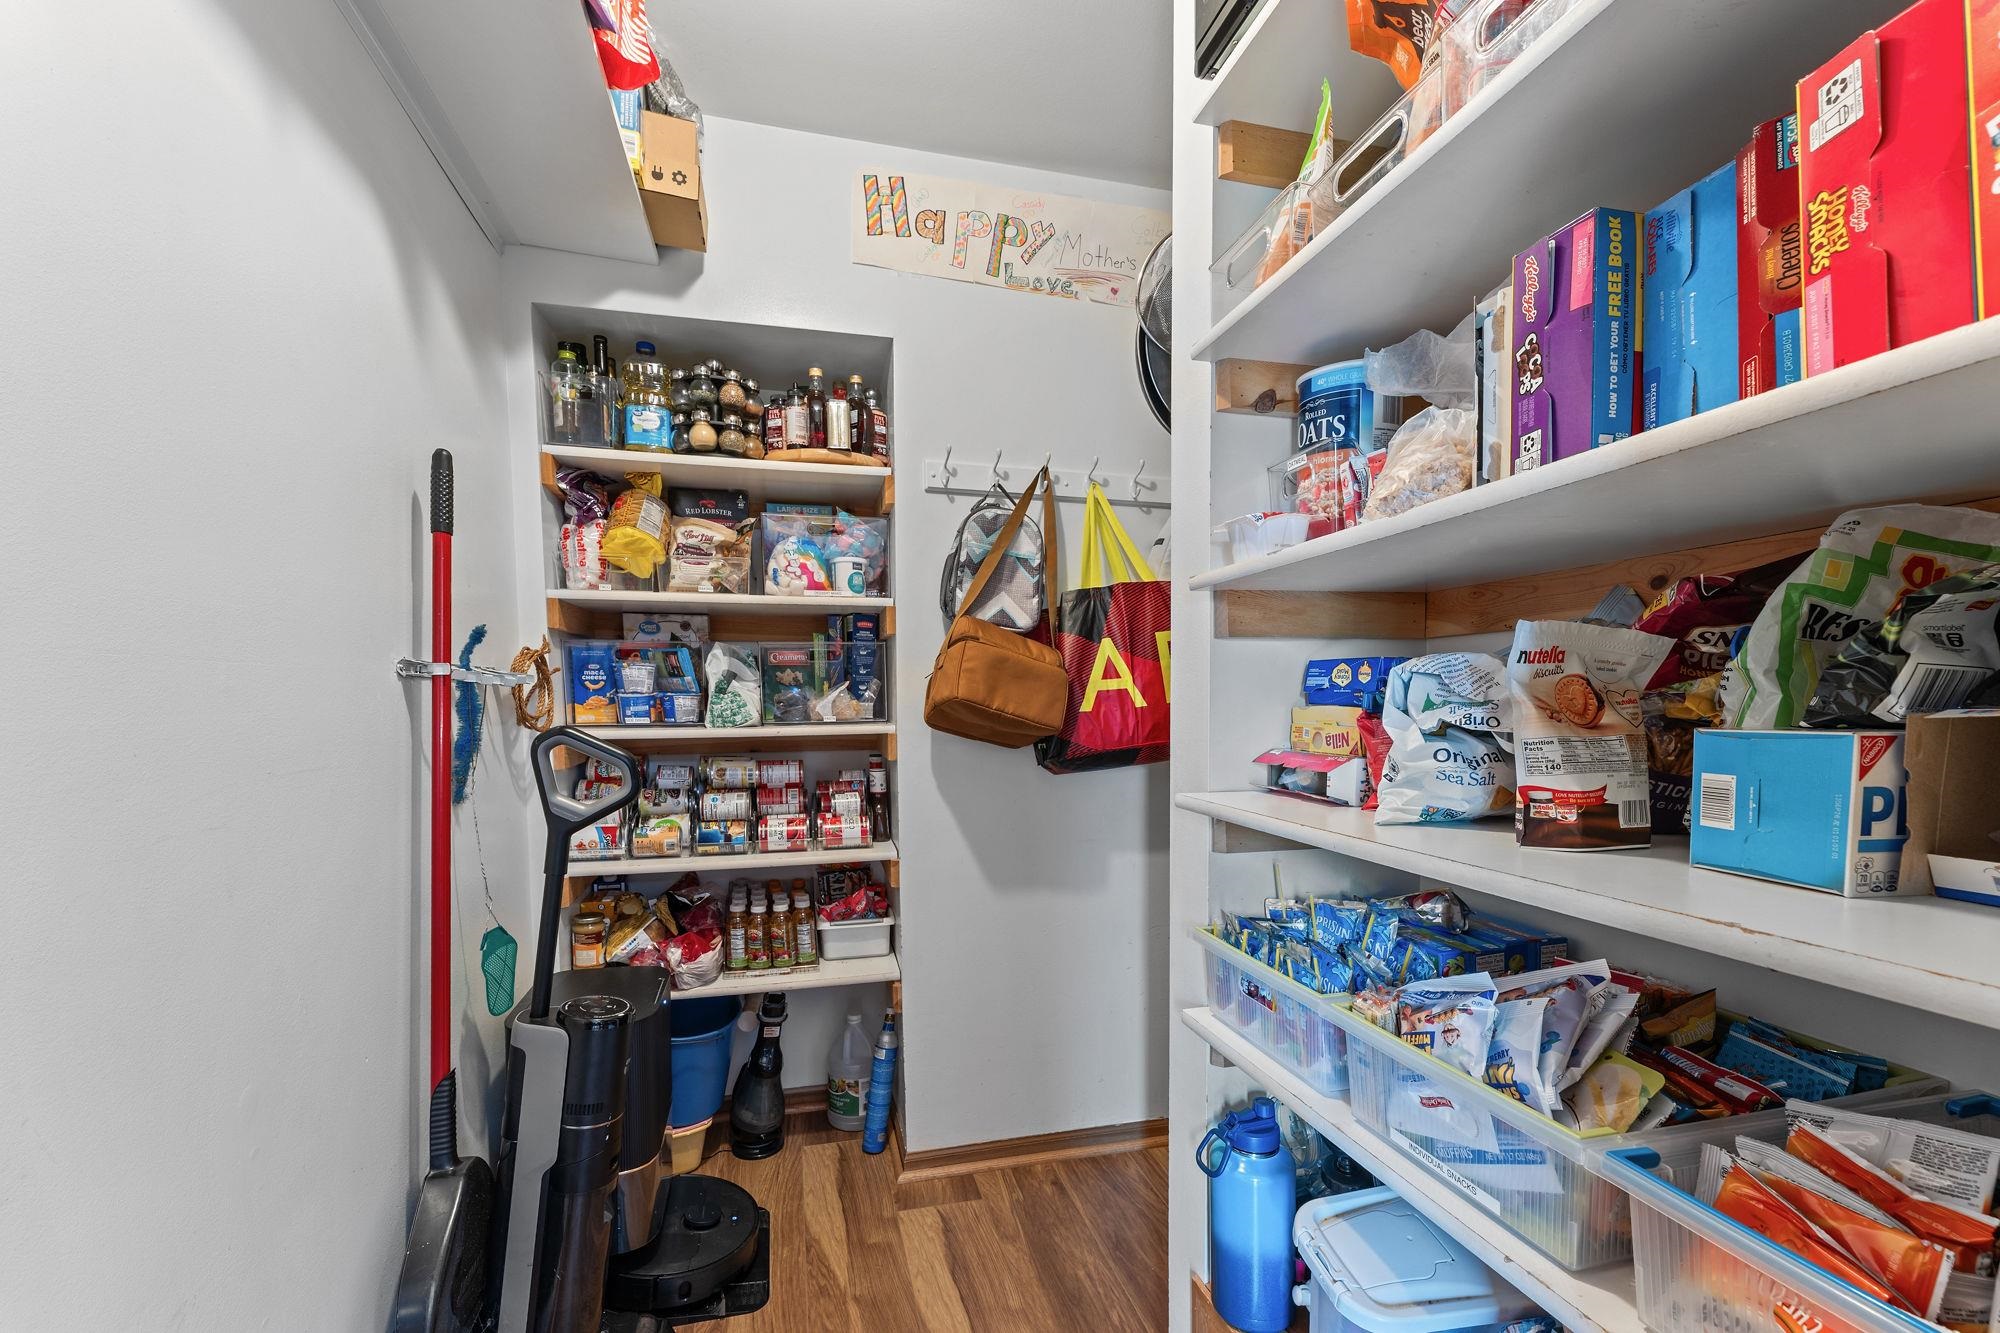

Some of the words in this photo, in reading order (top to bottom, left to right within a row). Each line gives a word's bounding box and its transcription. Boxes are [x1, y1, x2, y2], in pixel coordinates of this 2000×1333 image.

[1411, 9, 1425, 48] bear
[1786, 116, 1797, 142] SCAN
[1743, 214, 1748, 224] NO
[1827, 186, 1849, 253] HONEY
[1850, 185, 1870, 233] Kellogg's
[1609, 216, 1622, 266] BOOK
[1655, 216, 1663, 239] RICE
[1665, 209, 1677, 254] Millville
[1807, 191, 1829, 275] SMACKS
[1059, 233, 1137, 270] Mother's
[1647, 219, 1656, 276] SQUARES
[1776, 222, 1800, 290] Cheerios
[1765, 261, 1775, 279] Honey
[1522, 256, 1539, 323] Kellogg's
[1608, 270, 1622, 317] FREE
[1610, 321, 1619, 348] YOUR
[1610, 352, 1618, 373] GET
[1327, 373, 1349, 385] WHOLE
[1609, 376, 1617, 388] TO
[1305, 409, 1327, 421] ROLLED
[1608, 390, 1617, 418] HOW
[1298, 413, 1346, 448] OATS
[701, 507, 732, 517] LOBSTER
[1801, 603, 1871, 642] RES
[1517, 646, 1566, 664] nutella
[1533, 665, 1564, 679] biscuits
[1324, 730, 1350, 748] Nilla
[1863, 738, 1885, 765] NABISCO
[1433, 748, 1505, 771] Original
[1436, 770, 1465, 785] Sea
[1467, 772, 1496, 786] Salt
[1435, 1147, 1473, 1159] MUFFINS
[1408, 1142, 1446, 1175] INDIVIDUAL
[1445, 1170, 1478, 1196] SNACKS
